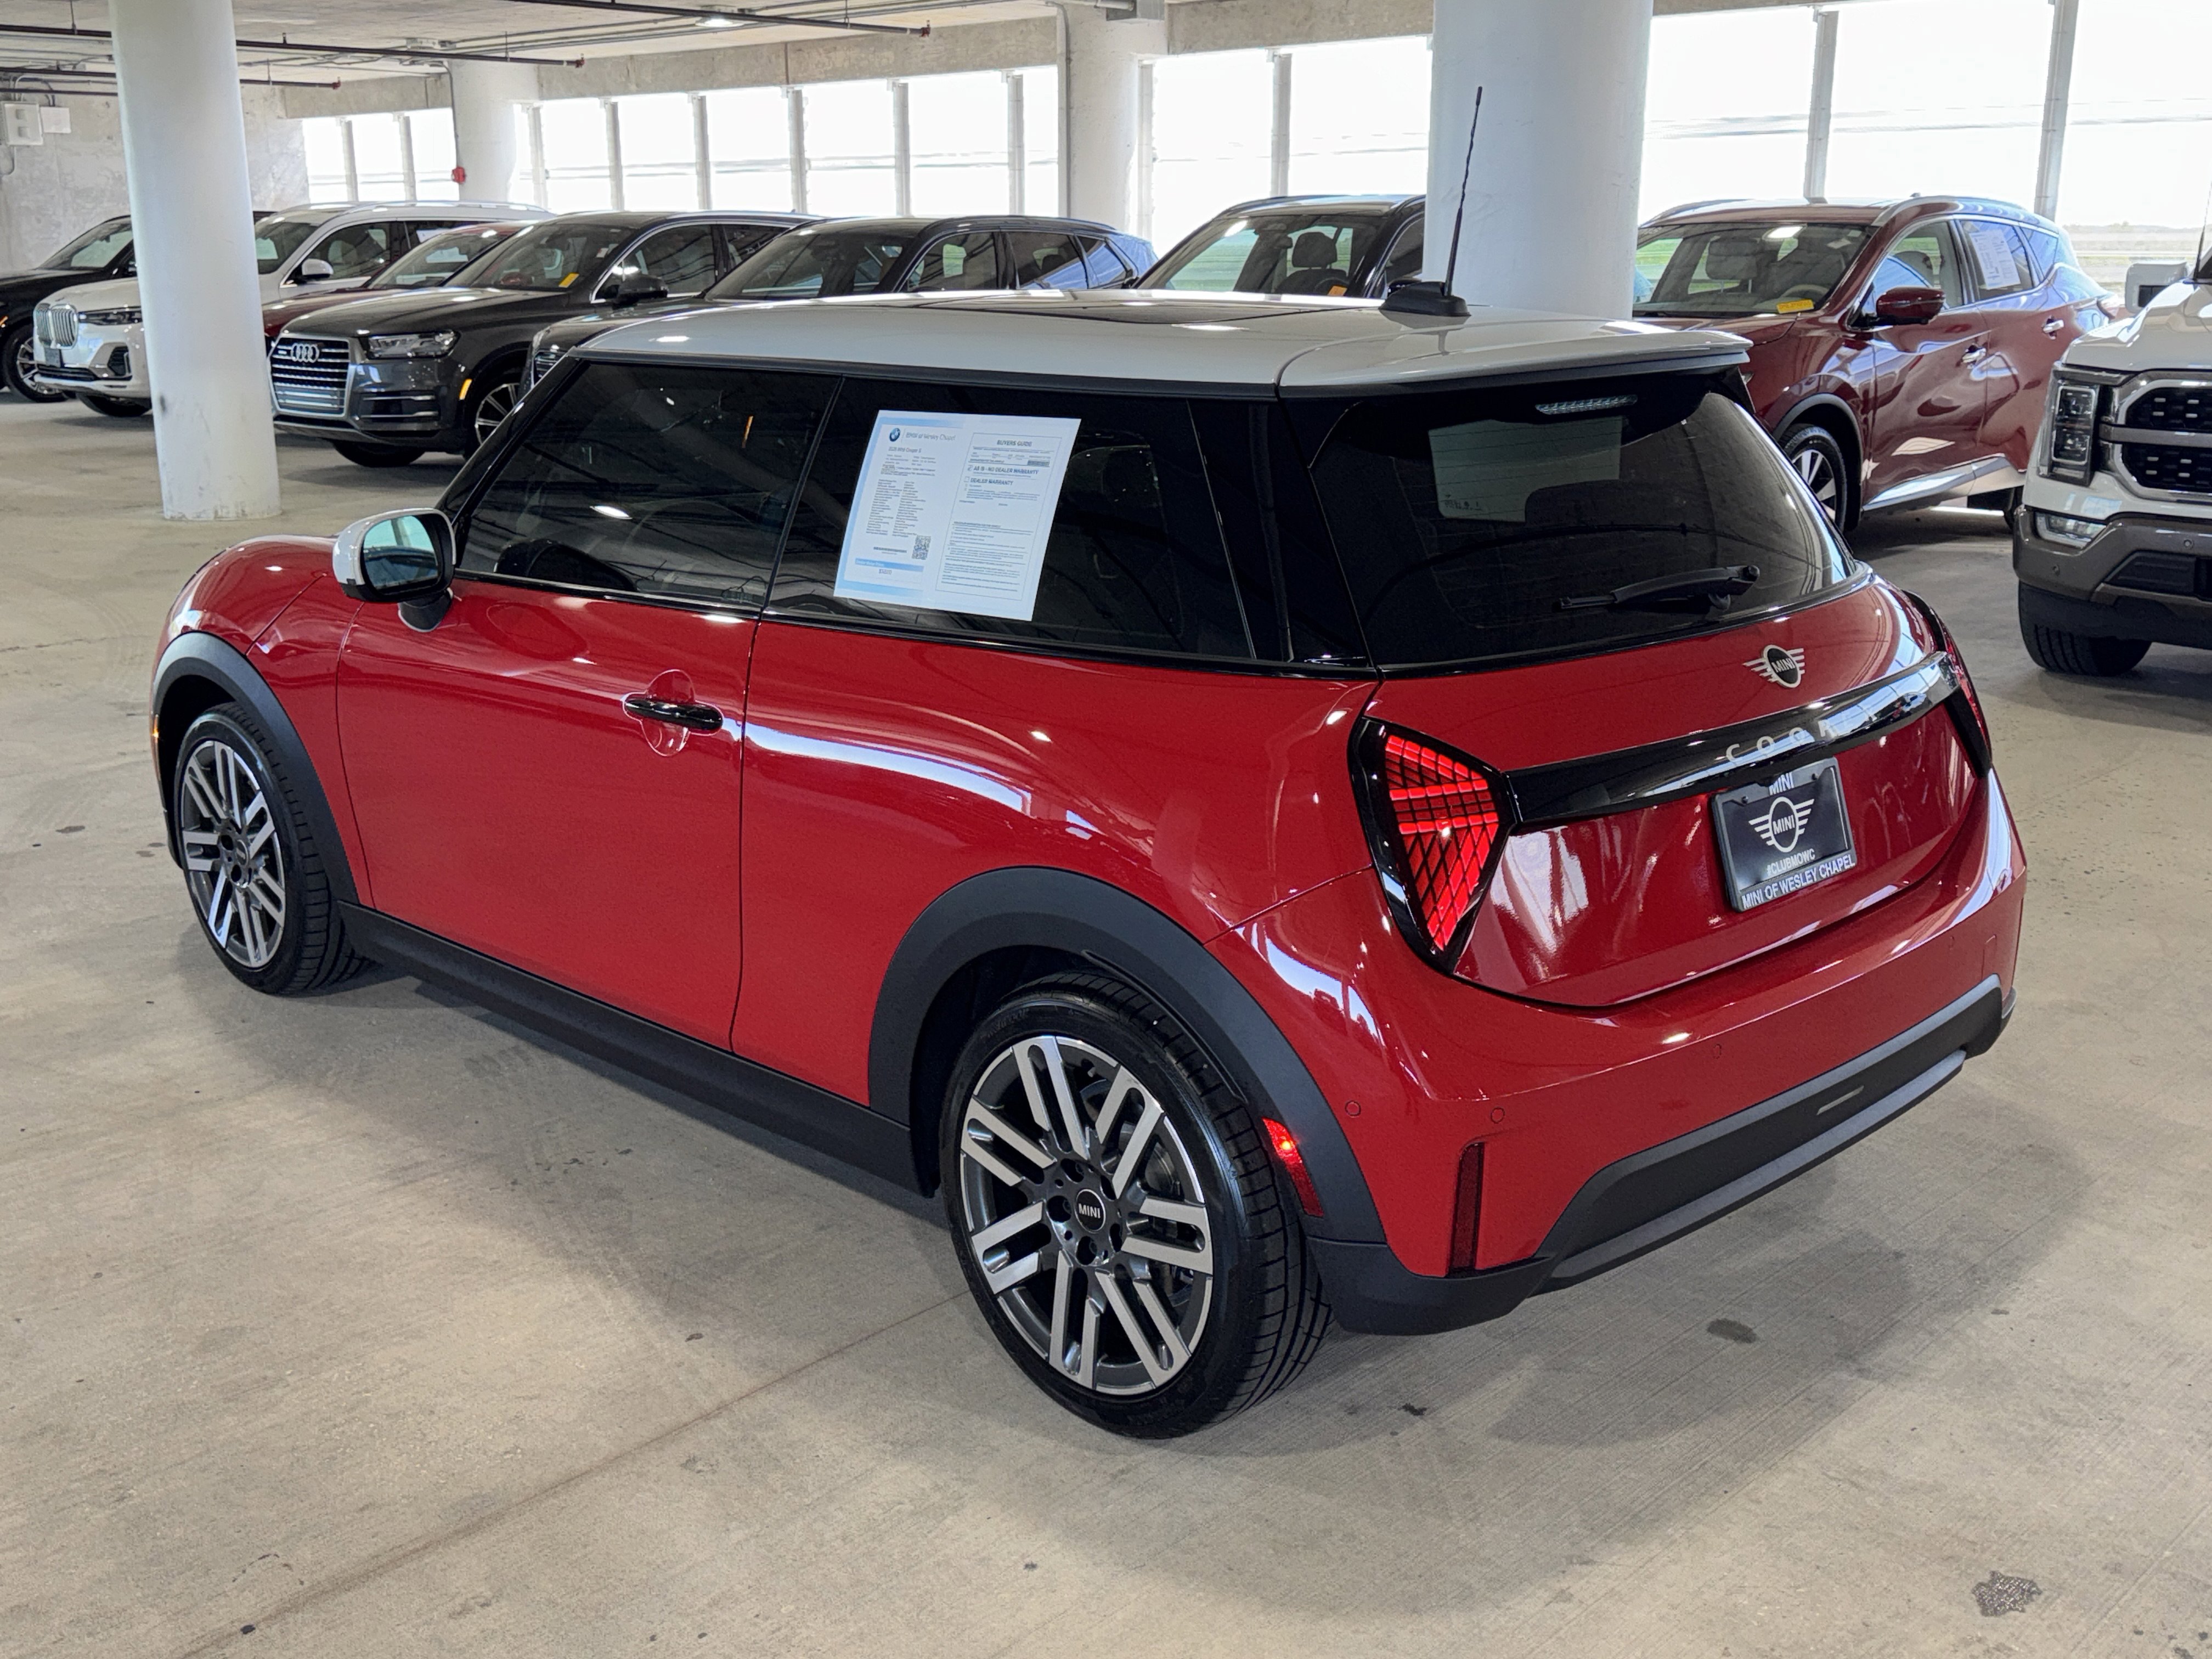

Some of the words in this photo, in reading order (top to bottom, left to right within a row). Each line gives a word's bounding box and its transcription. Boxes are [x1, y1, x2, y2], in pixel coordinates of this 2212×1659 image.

[1771, 657, 1796, 673] MINI
[1768, 772, 1795, 795] MINI
[1772, 814, 1796, 835] MINI
[1766, 848, 1816, 877] #CLUBMOWC
[1741, 889, 1763, 910] MINI
[1764, 882, 1779, 900] OF
[1779, 868, 1818, 894] WESLEY
[1819, 854, 1856, 879] CHAPEL
[1078, 1203, 1101, 1219] MINI
